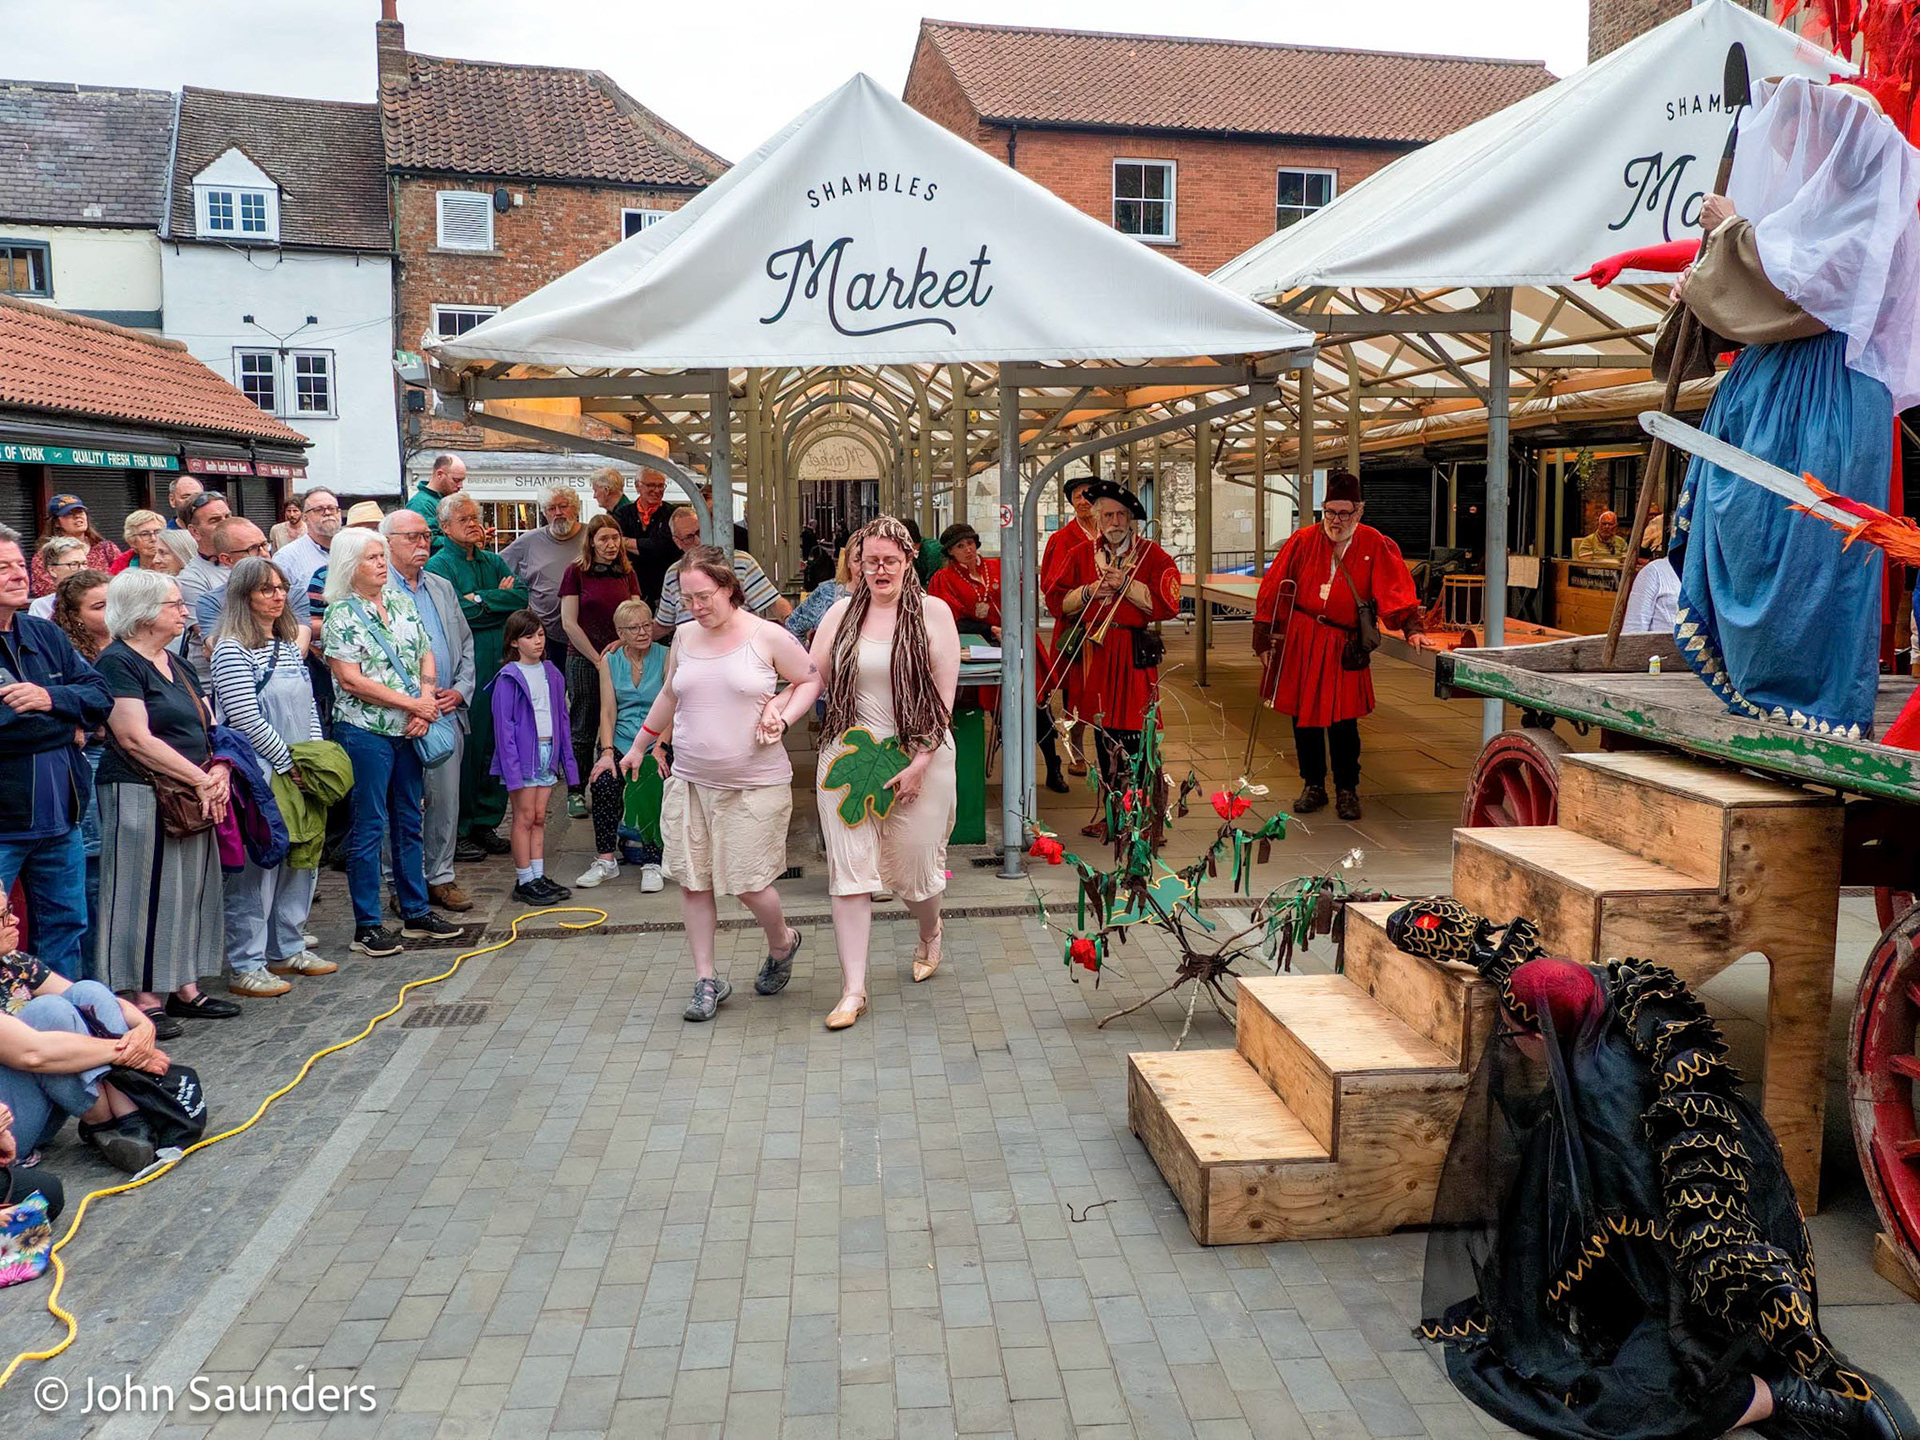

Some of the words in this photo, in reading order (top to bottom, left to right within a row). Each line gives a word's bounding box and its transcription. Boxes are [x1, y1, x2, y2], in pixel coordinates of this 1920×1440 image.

[807, 172, 938, 208] SHAMBLES
[759, 237, 993, 336] Market
[4, 446, 17, 460] OF
[19, 446, 45, 461] YORK
[72, 450, 104, 465] QUALITY
[107, 453, 131, 466] FRESH
[133, 454, 149, 468] FISH
[149, 456, 168, 468] DAILY
